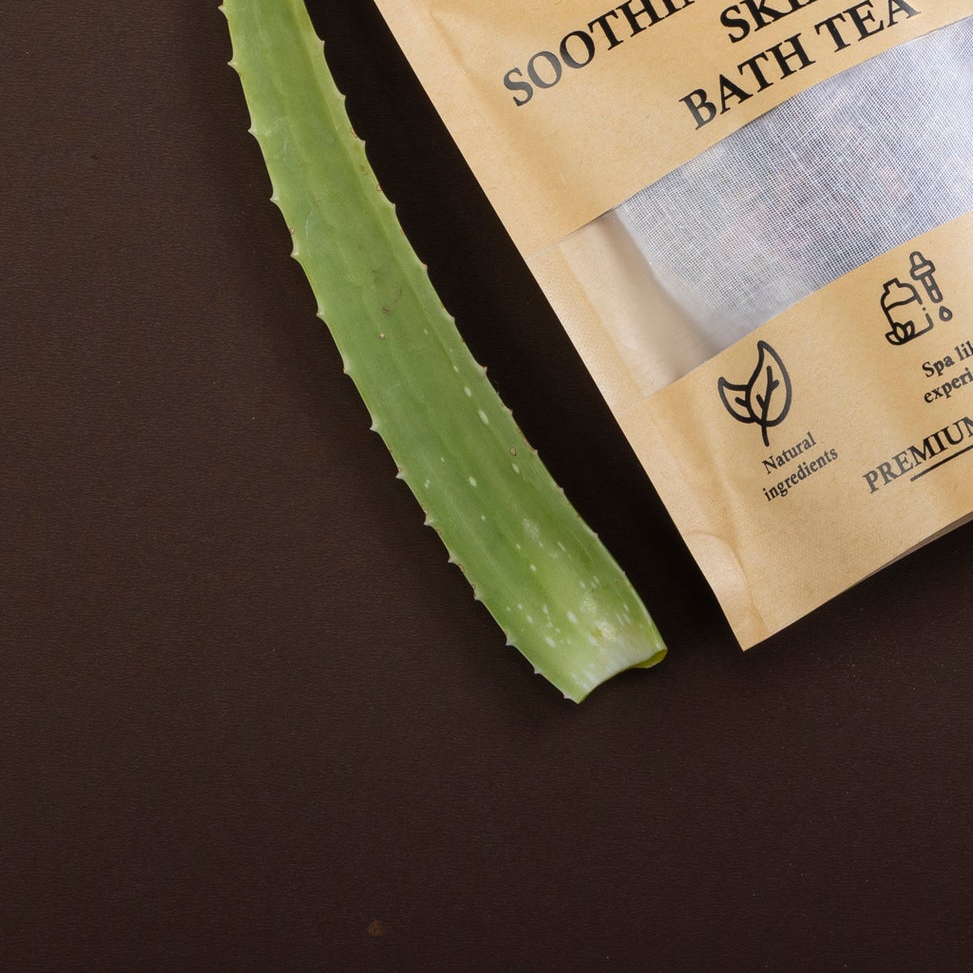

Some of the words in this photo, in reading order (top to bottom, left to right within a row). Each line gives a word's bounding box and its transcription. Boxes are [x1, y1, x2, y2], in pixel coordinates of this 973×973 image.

[679, 32, 817, 130] BATH
[922, 353, 955, 379] Spa
[761, 432, 817, 475] Natural
[762, 444, 839, 503] ingredients
